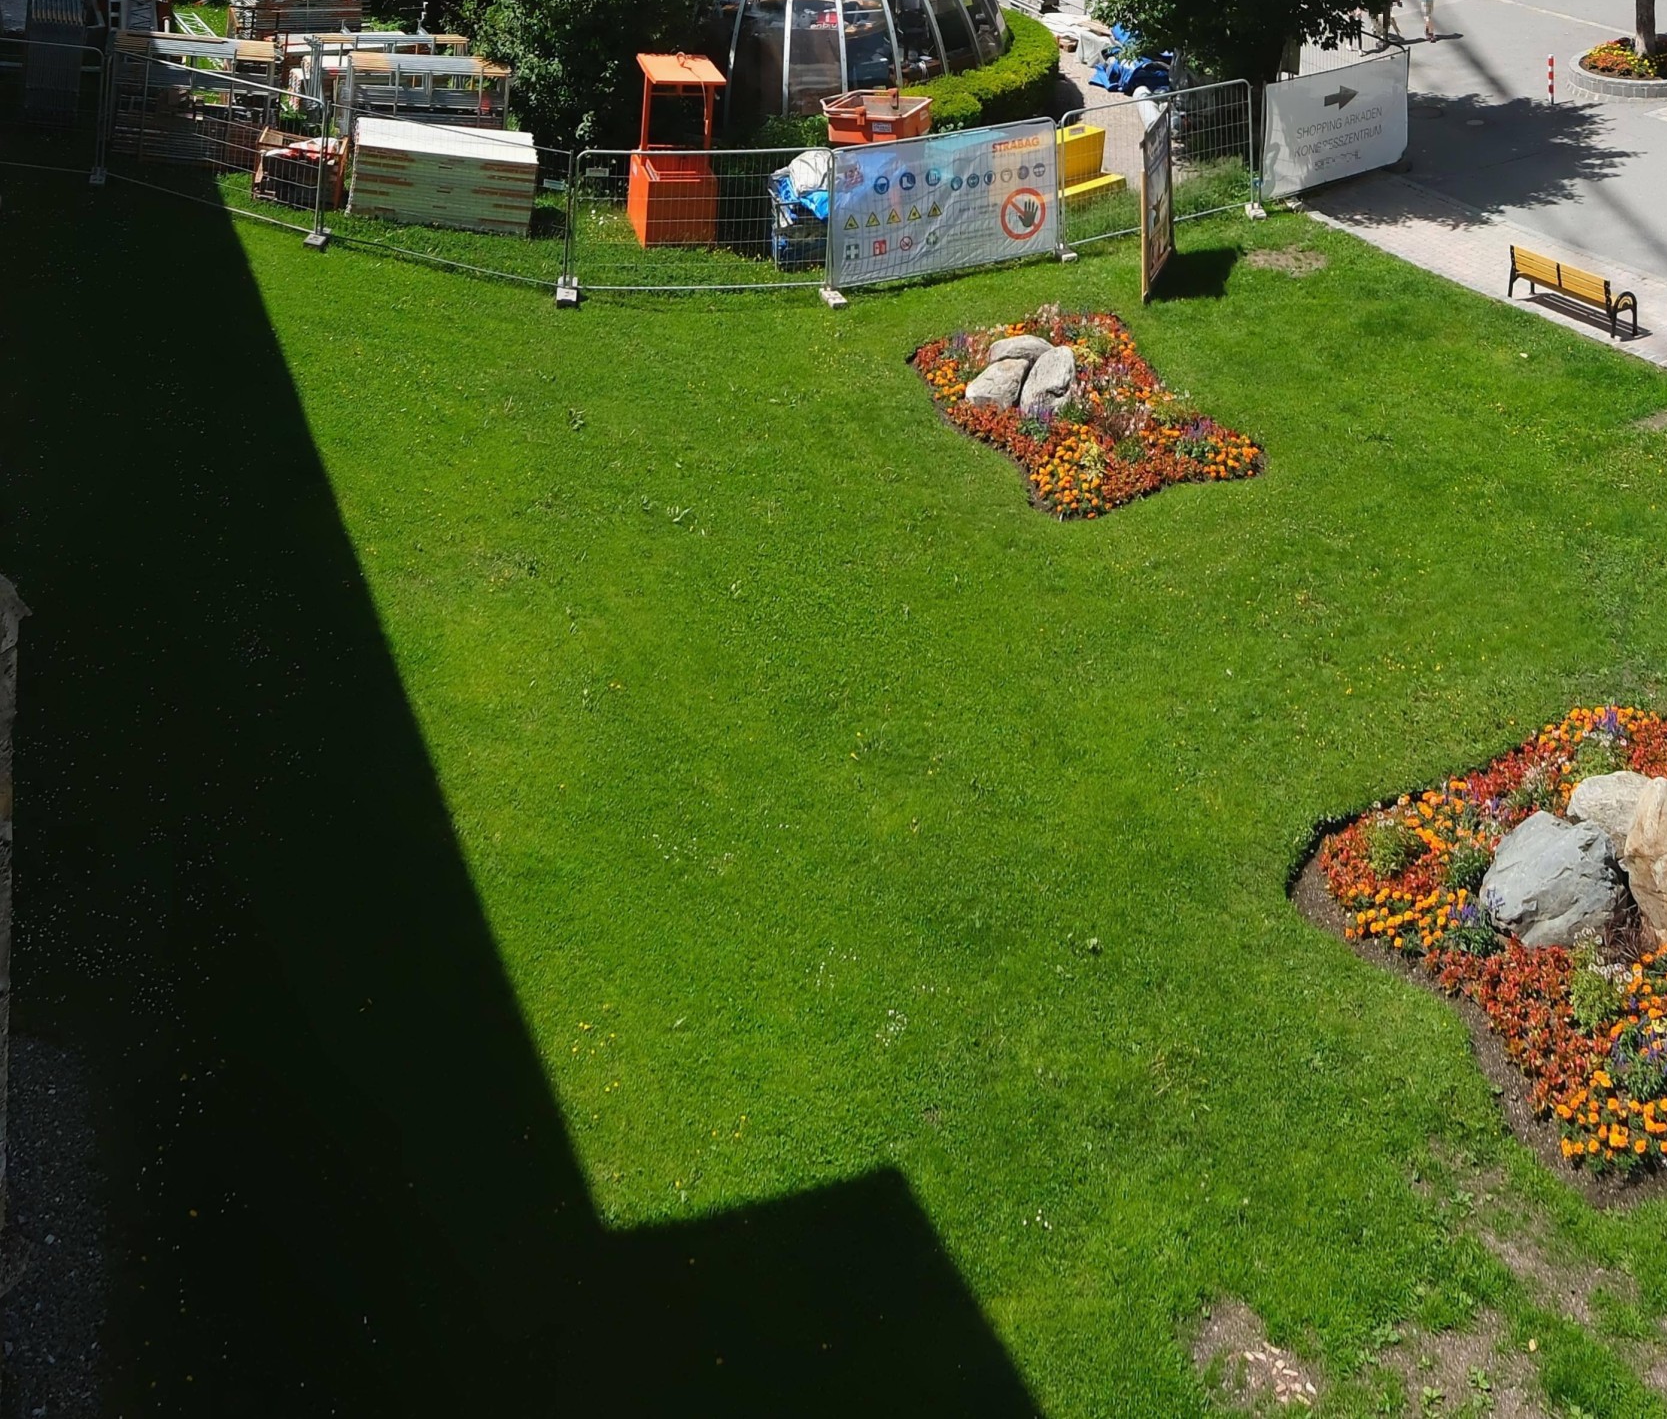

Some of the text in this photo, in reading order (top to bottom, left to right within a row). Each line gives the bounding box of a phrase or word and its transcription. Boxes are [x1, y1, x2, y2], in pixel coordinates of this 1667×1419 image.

[1296, 106, 1383, 139] SHOPPING ARKADEN
[992, 136, 1040, 153] STRABAG
